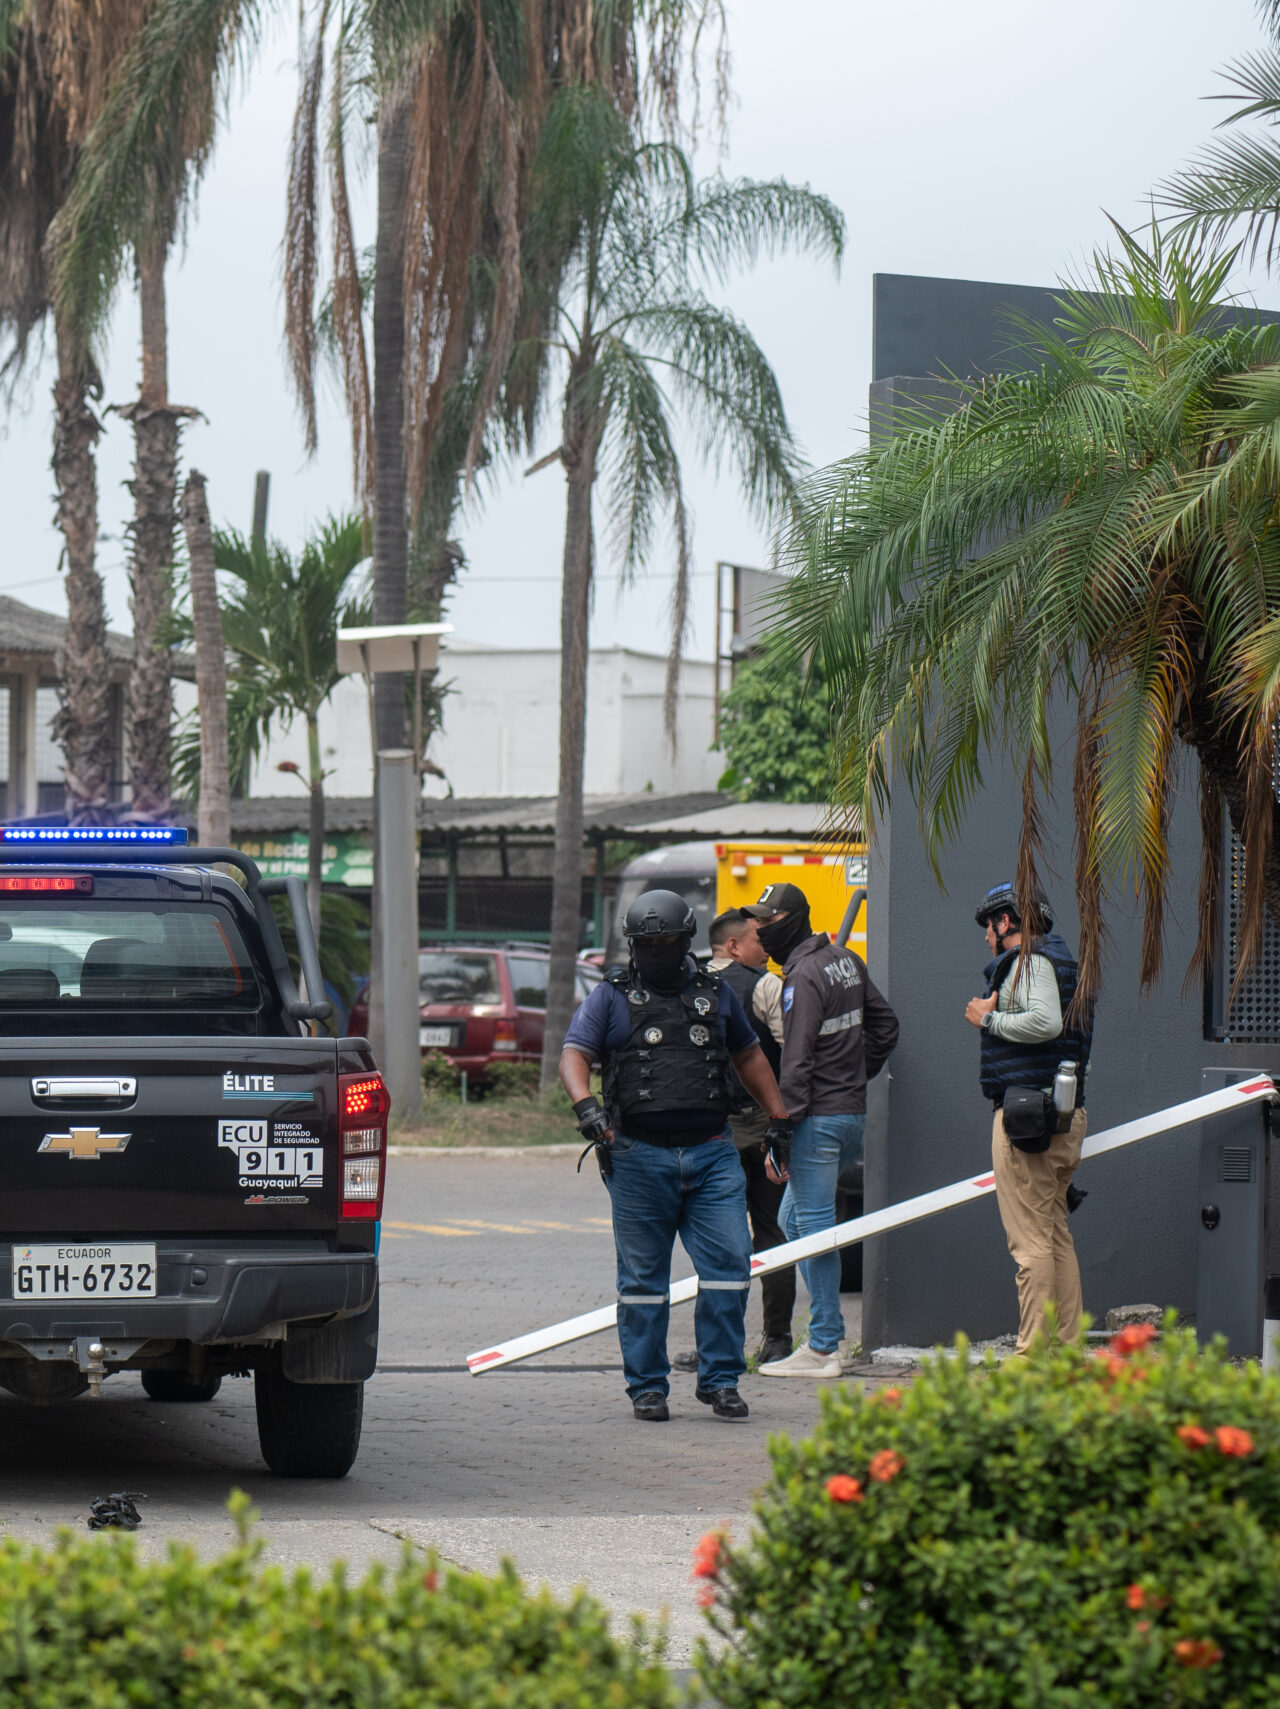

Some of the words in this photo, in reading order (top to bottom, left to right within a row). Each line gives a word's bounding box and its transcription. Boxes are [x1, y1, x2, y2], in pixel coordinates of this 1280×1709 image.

[223, 1070, 275, 1091] ÉLITE
[222, 1125, 263, 1143] ECU
[246, 1151, 314, 1171] 911
[239, 1176, 298, 1190] Guayaquil
[58, 1248, 112, 1259] ECUADOR
[18, 1263, 152, 1293] GTH-6732
